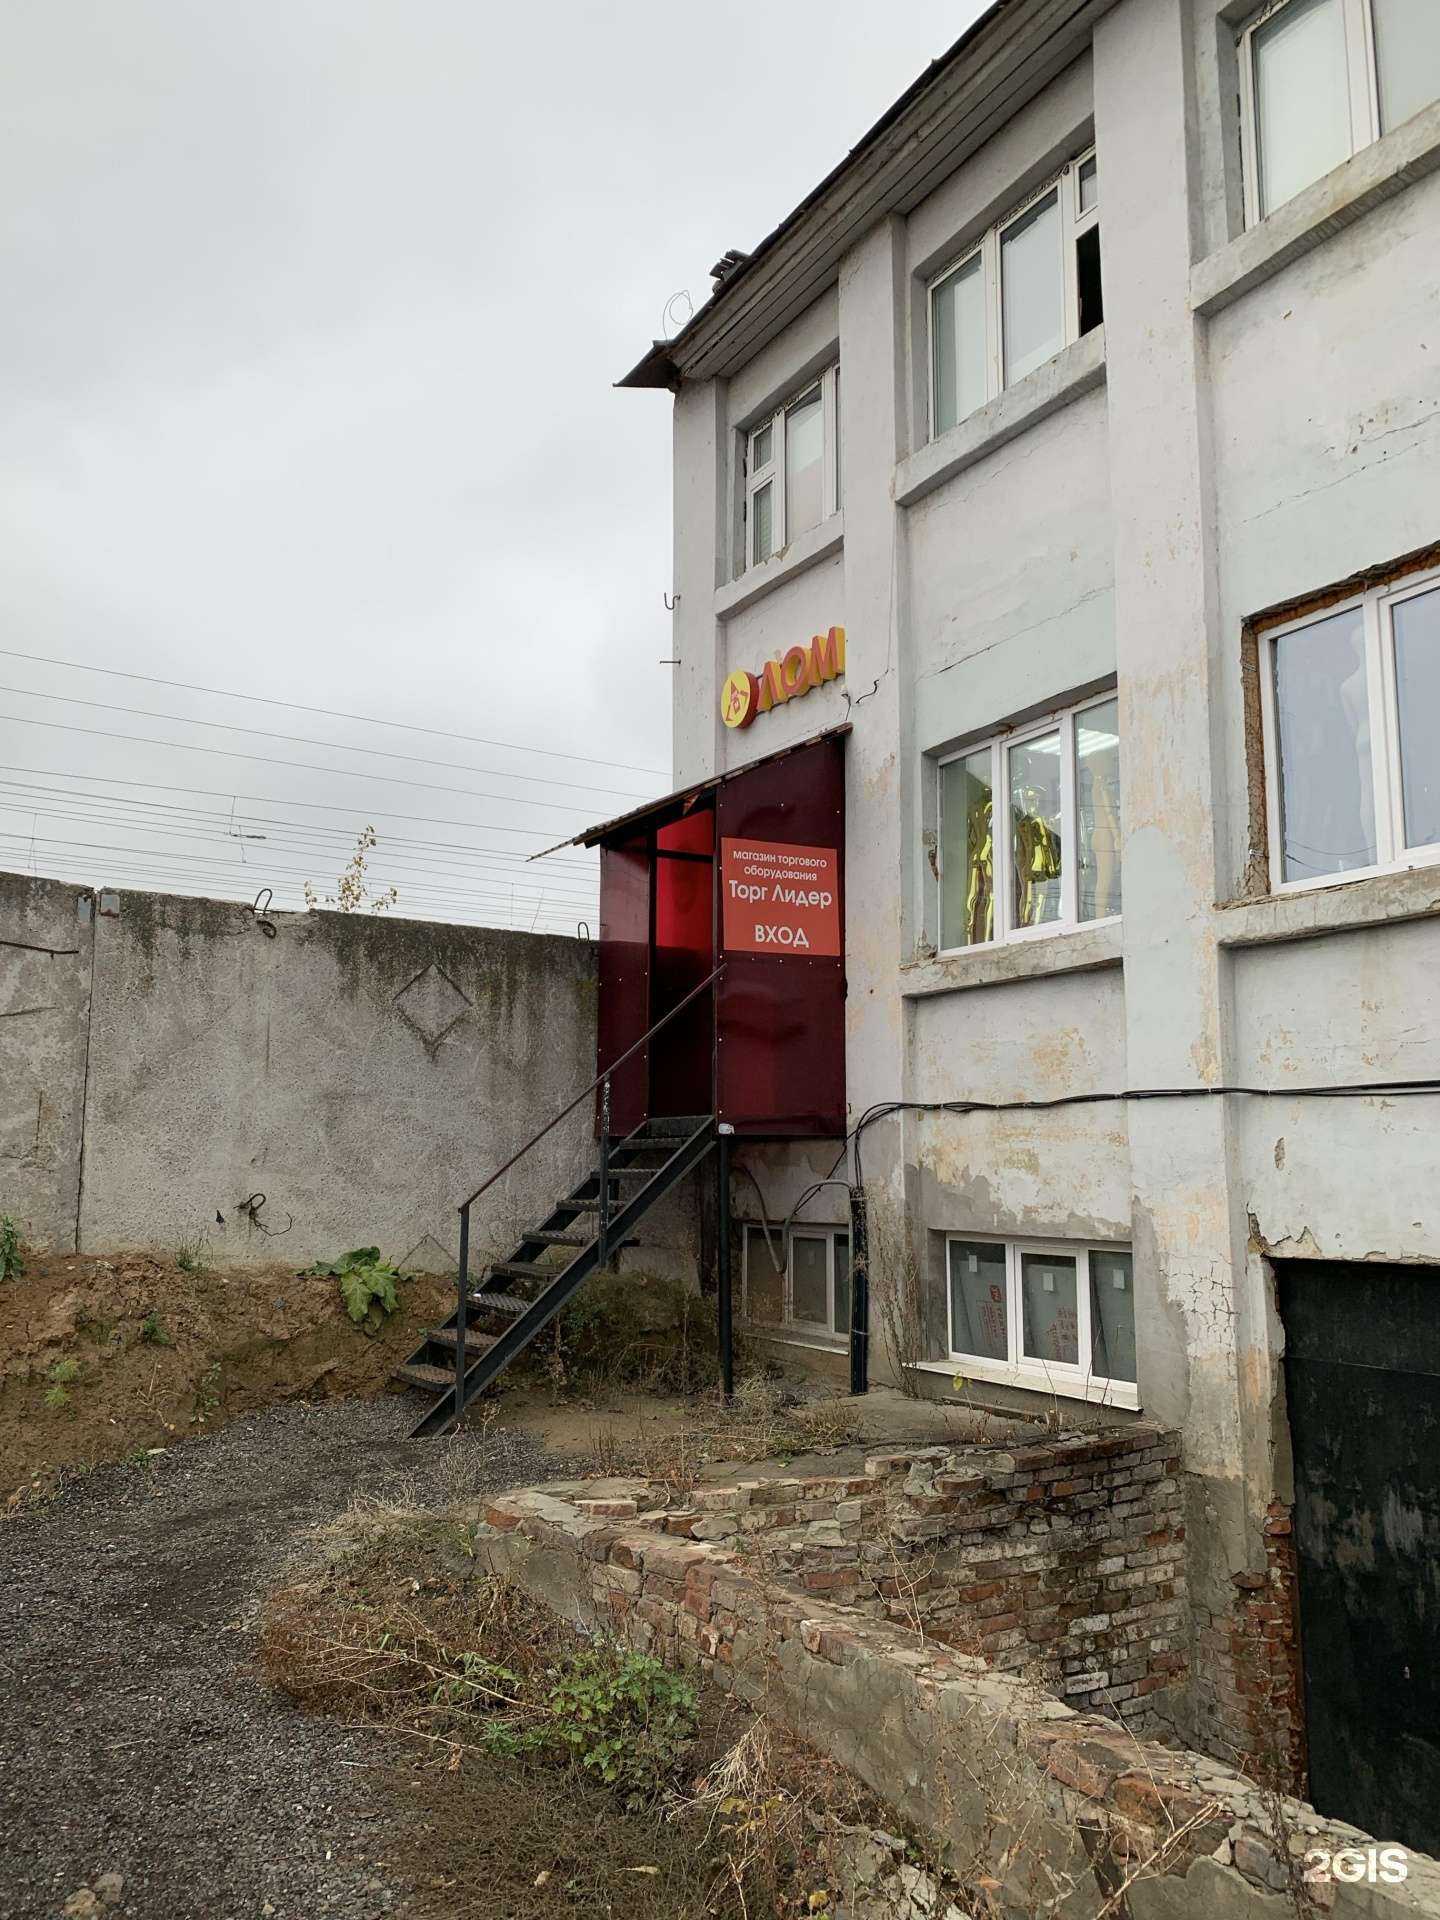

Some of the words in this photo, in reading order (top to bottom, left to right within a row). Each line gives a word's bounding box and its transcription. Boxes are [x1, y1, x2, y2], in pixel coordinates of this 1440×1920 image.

[733, 851, 776, 863] магазин
[778, 855, 827, 868] торгового
[744, 865, 817, 880] оборудования
[729, 880, 768, 903] Торг
[772, 884, 832, 909] Лидер
[755, 924, 809, 948] ВХОД
